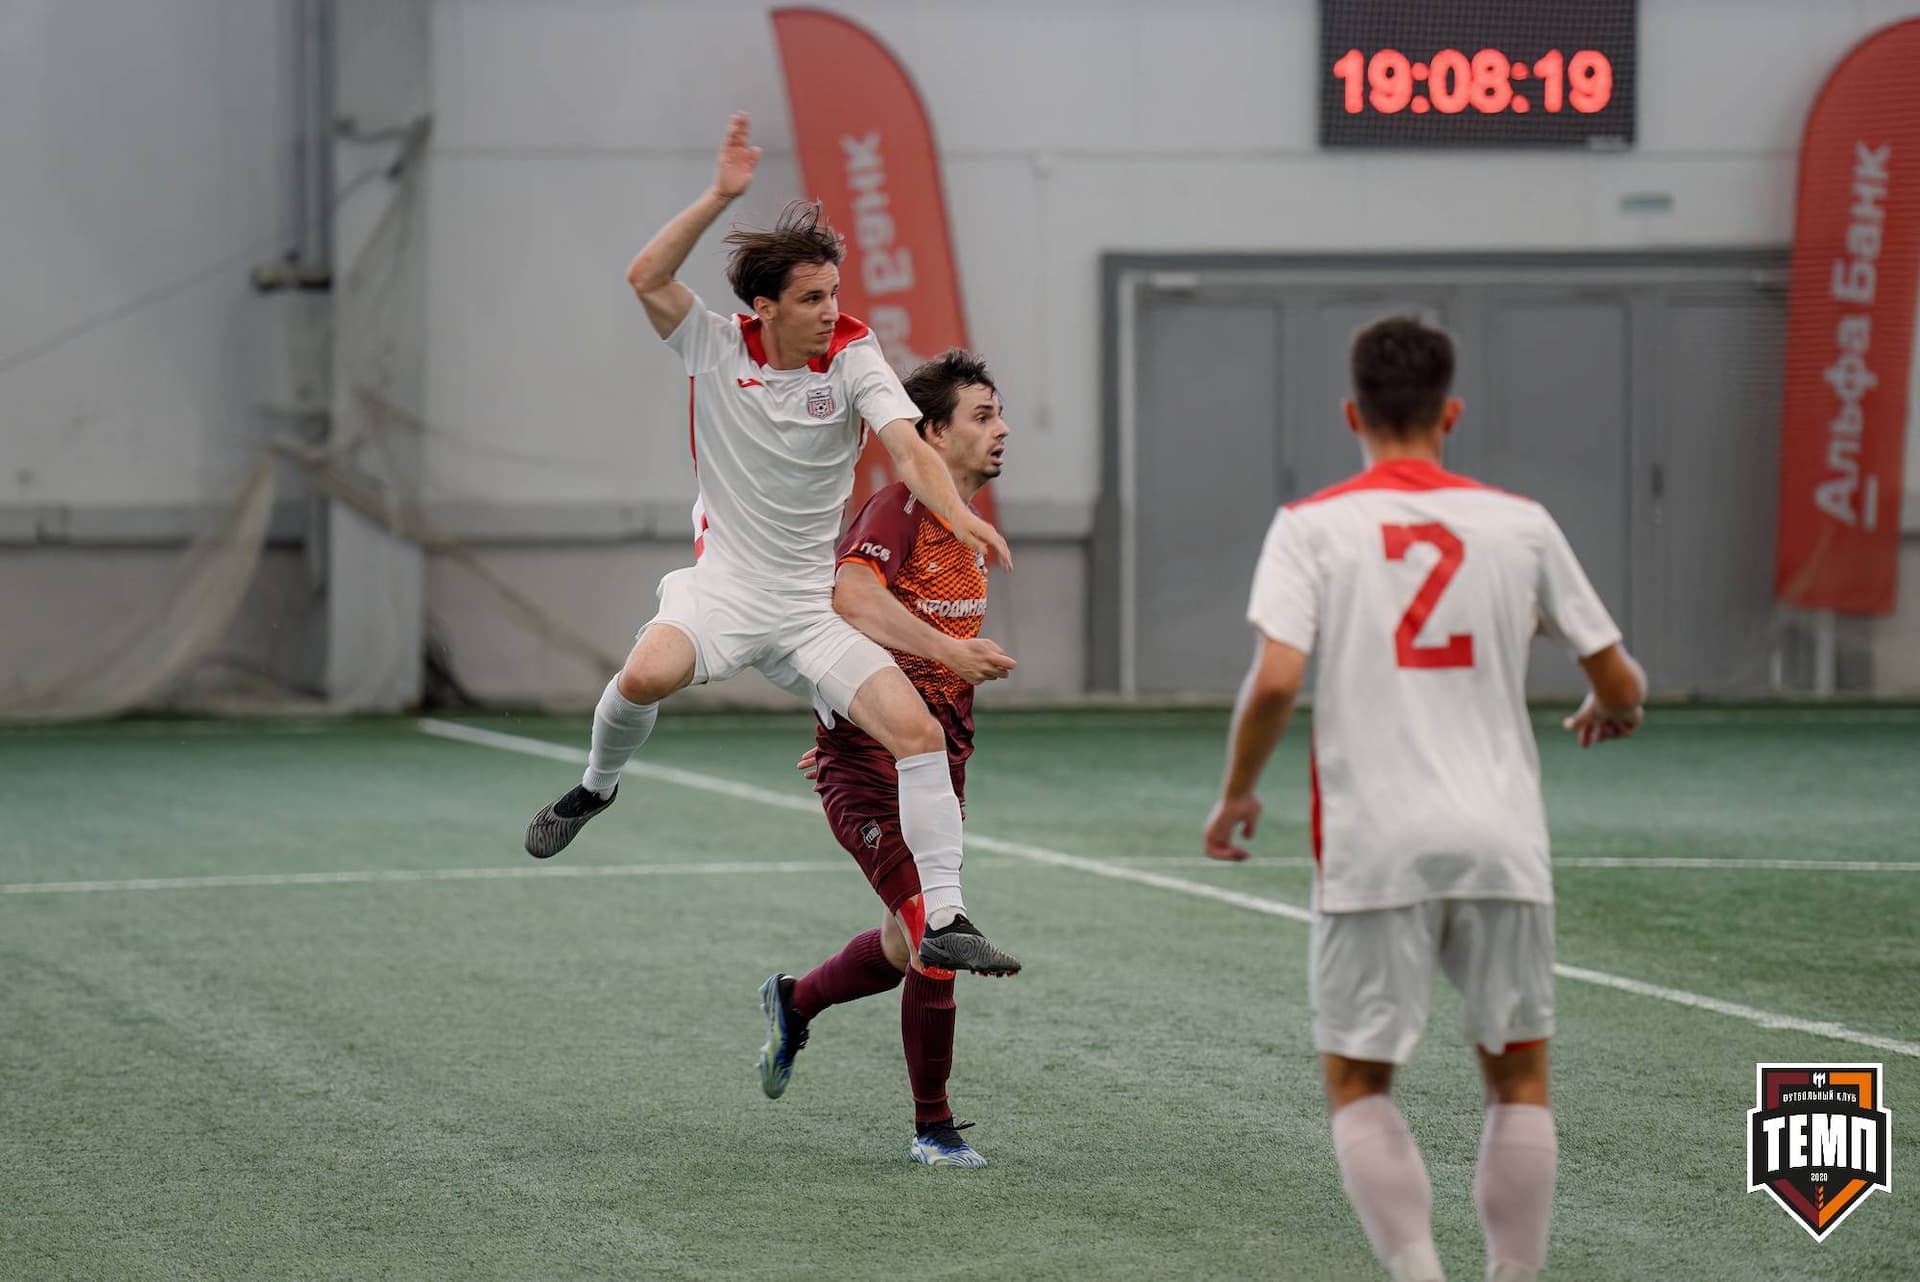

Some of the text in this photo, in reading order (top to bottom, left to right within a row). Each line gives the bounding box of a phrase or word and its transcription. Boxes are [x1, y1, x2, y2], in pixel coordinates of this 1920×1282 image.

[1333, 48, 1613, 114] 19:08:19
[1814, 140, 1892, 527] Альфа Банк
[1381, 521, 1475, 668] 2
